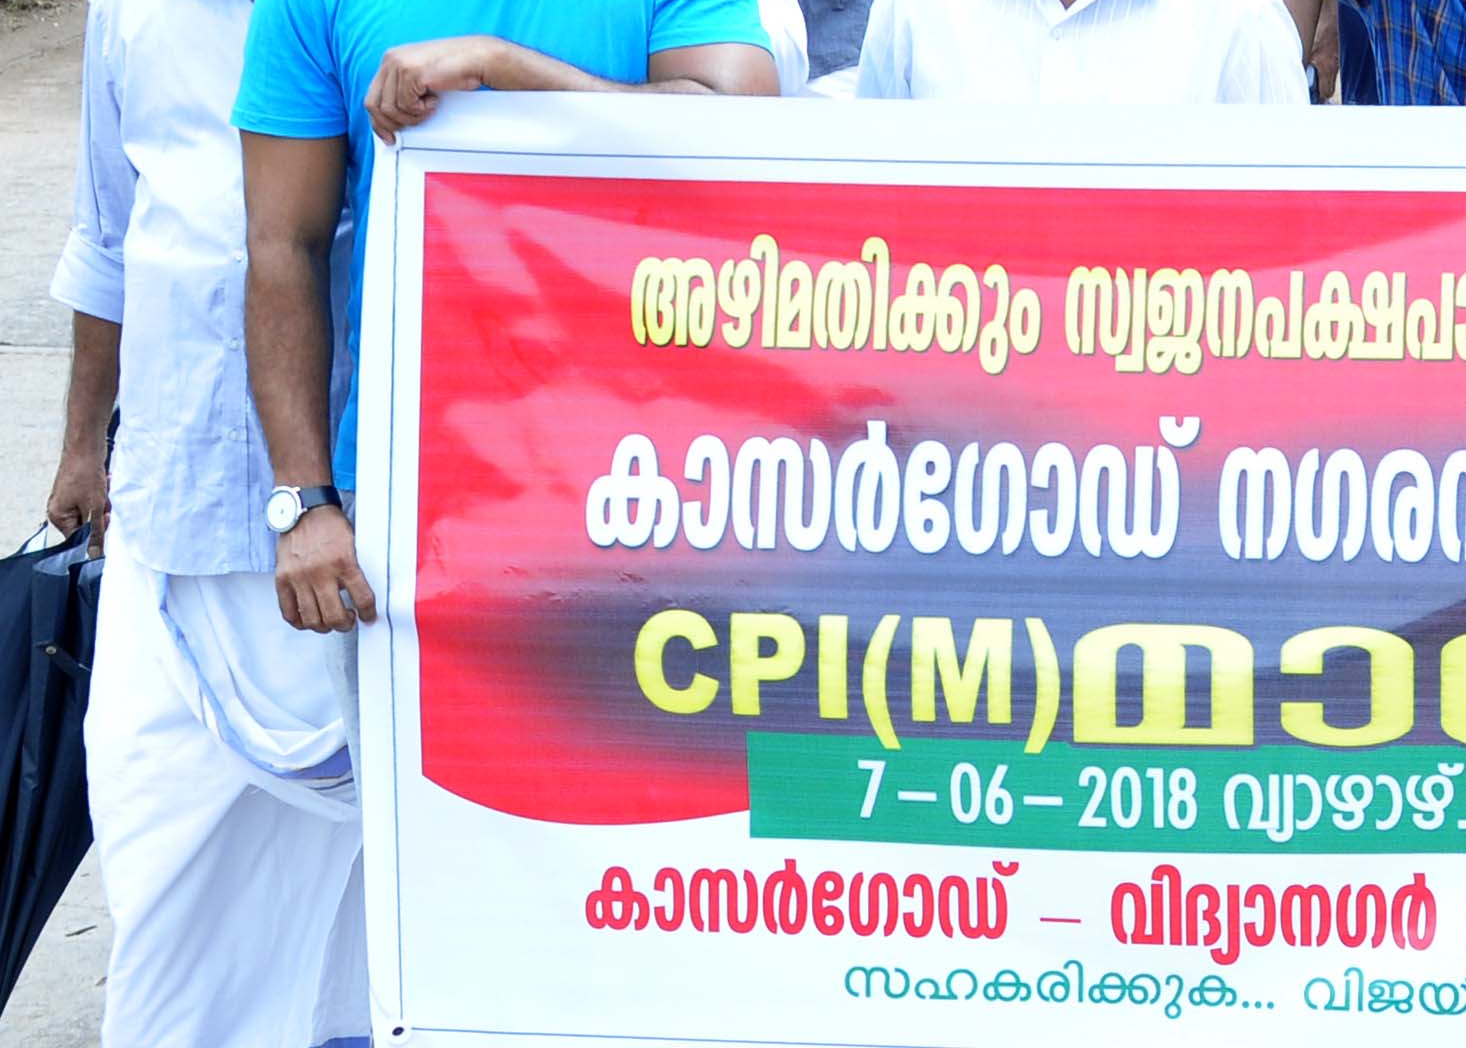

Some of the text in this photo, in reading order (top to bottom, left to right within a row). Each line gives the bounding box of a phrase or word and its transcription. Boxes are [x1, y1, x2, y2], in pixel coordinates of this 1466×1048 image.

[631, 233, 1042, 375] അഴിമതിക്കും
[585, 415, 1201, 558] കാസർഗോഡ്
[585, 858, 1019, 940] കാസർഗോഡ്
[1111, 864, 1438, 966] വിദ്യാനഗർ
